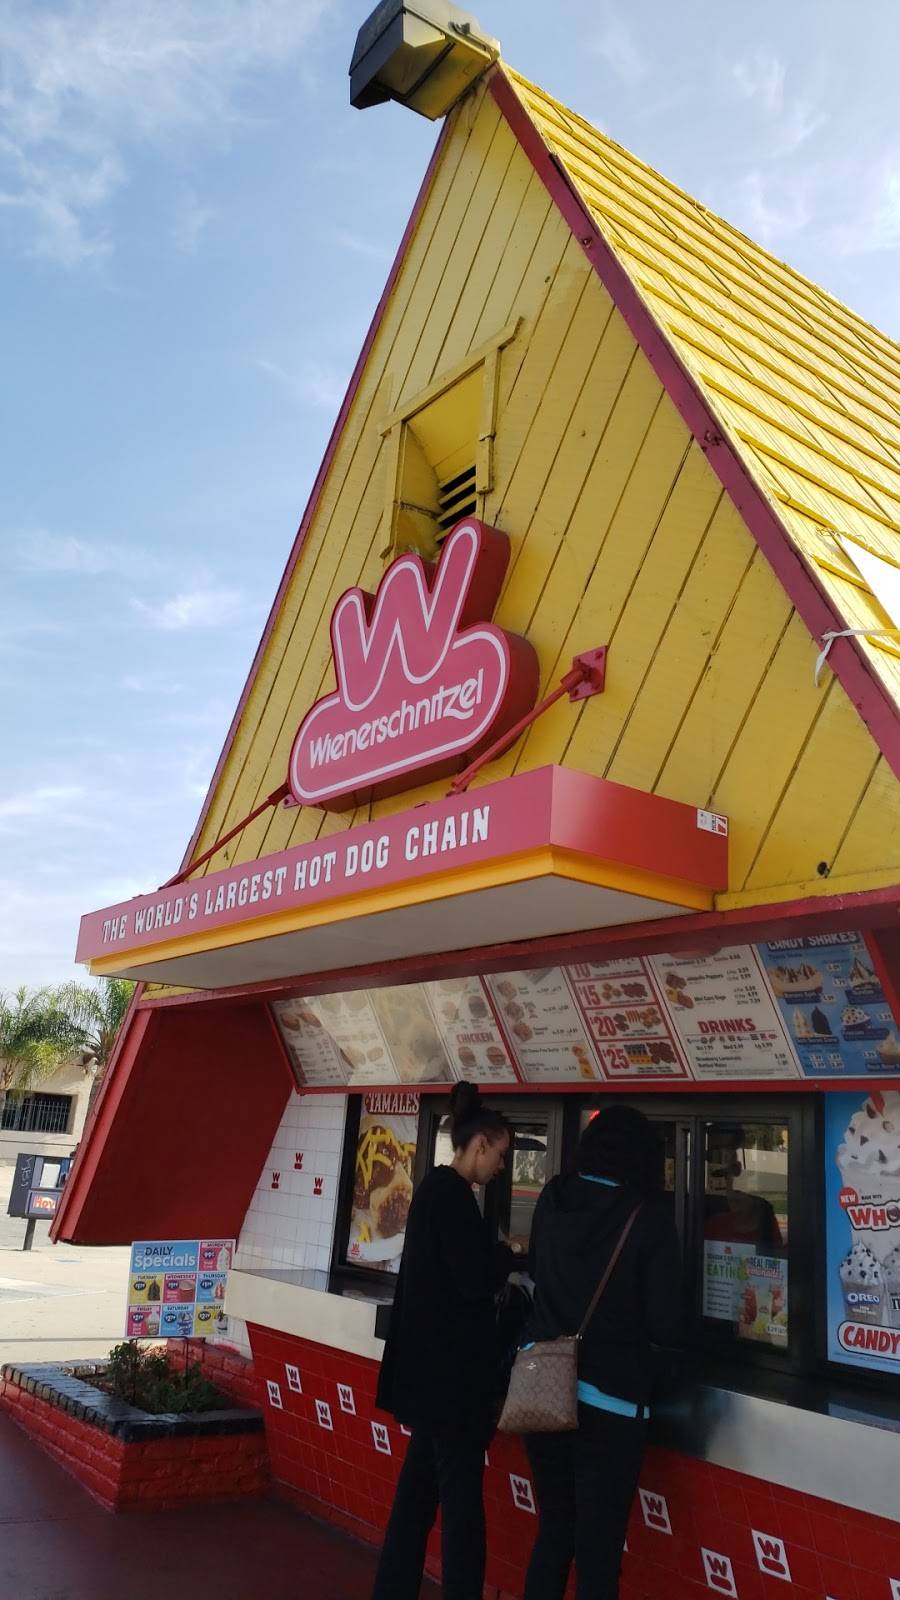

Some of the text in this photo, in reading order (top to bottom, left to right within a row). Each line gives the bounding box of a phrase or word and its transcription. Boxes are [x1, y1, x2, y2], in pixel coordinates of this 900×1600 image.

[309, 668, 484, 768] Wienerschnitzel
[102, 805, 491, 943] THE WORLD'S LARGEST HOT DOG CHAIN
[808, 931, 858, 946] SHAKES
[697, 1018, 756, 1034] DRINKS
[456, 1032, 495, 1044] CHICKEN
[368, 1092, 420, 1114] TAMALES
[145, 1246, 174, 1256] DAILY
[134, 1253, 196, 1270] Specials
[847, 1292, 880, 1303] OREO
[843, 1325, 900, 1354] CANDY
